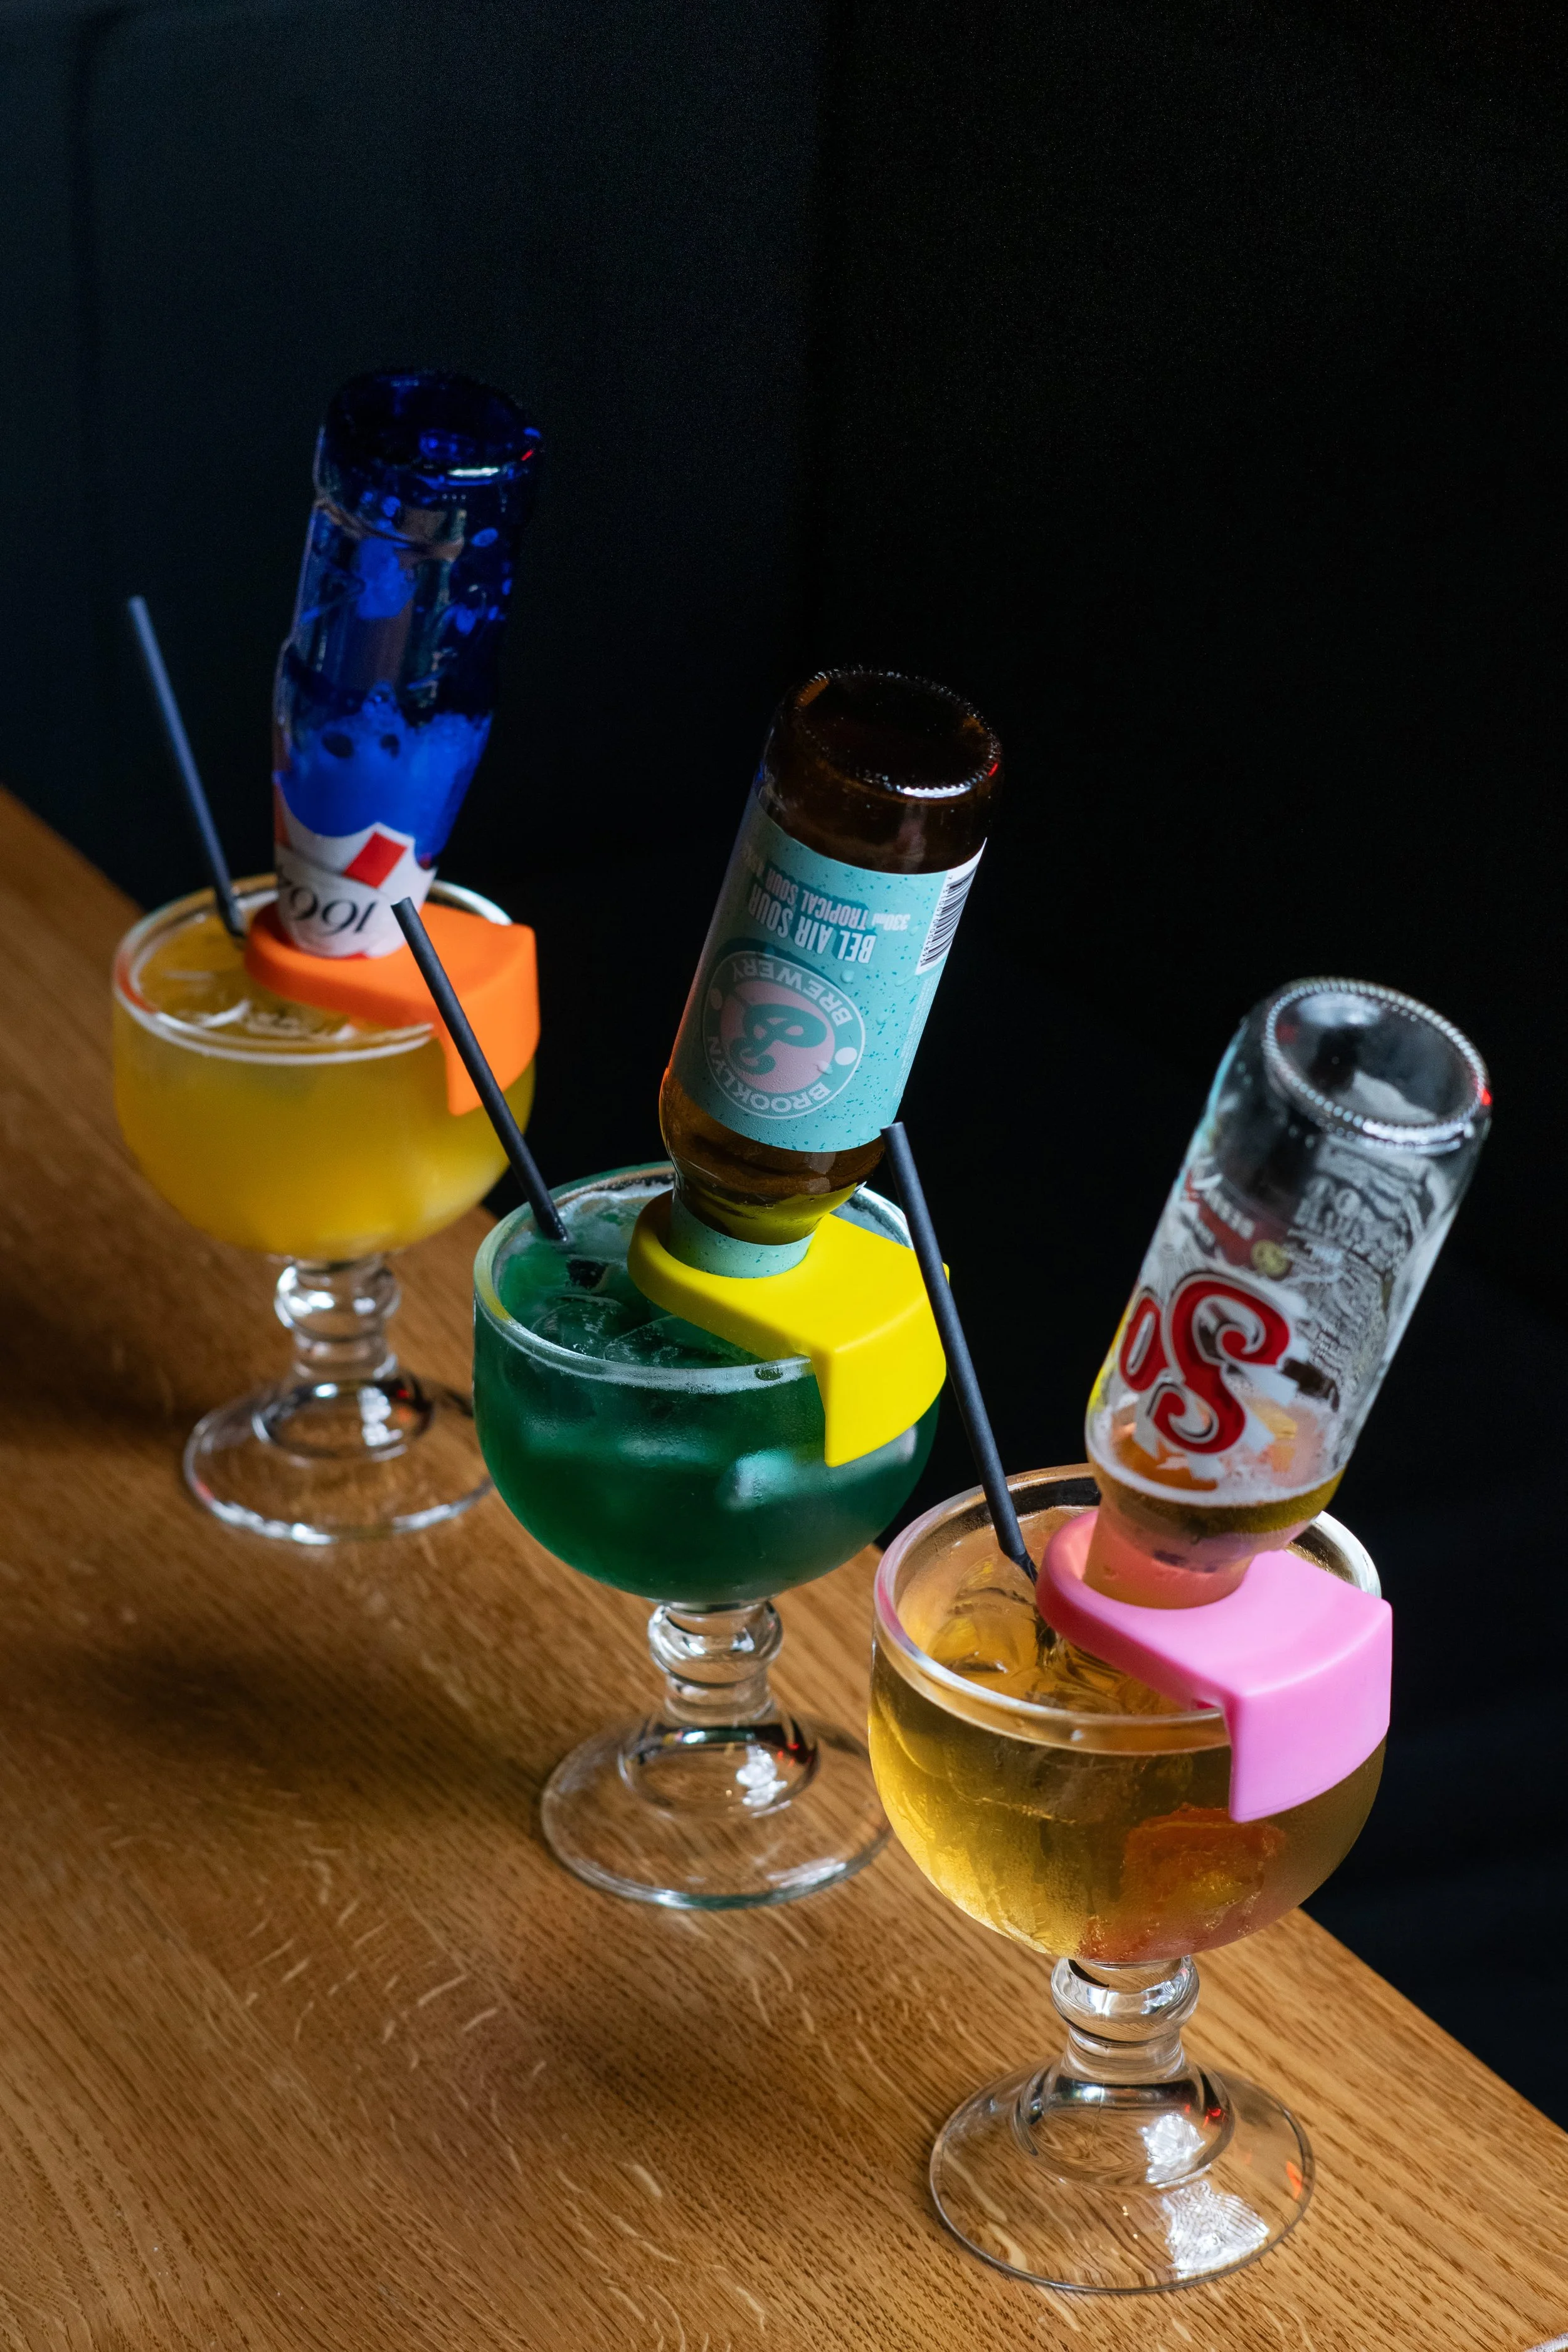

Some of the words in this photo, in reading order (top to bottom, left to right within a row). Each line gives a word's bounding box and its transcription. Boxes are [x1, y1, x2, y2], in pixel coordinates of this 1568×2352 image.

[280, 879, 378, 935] 166
[765, 867, 800, 908] SOUR
[748, 882, 794, 939] SOUR
[800, 889, 869, 931] TROPICAL
[871, 913, 911, 931] 330ml
[794, 914, 834, 955] AIR
[837, 930, 877, 964] BEL
[731, 958, 854, 1028] BREWERY
[709, 1036, 833, 1113] BROOKLYN
